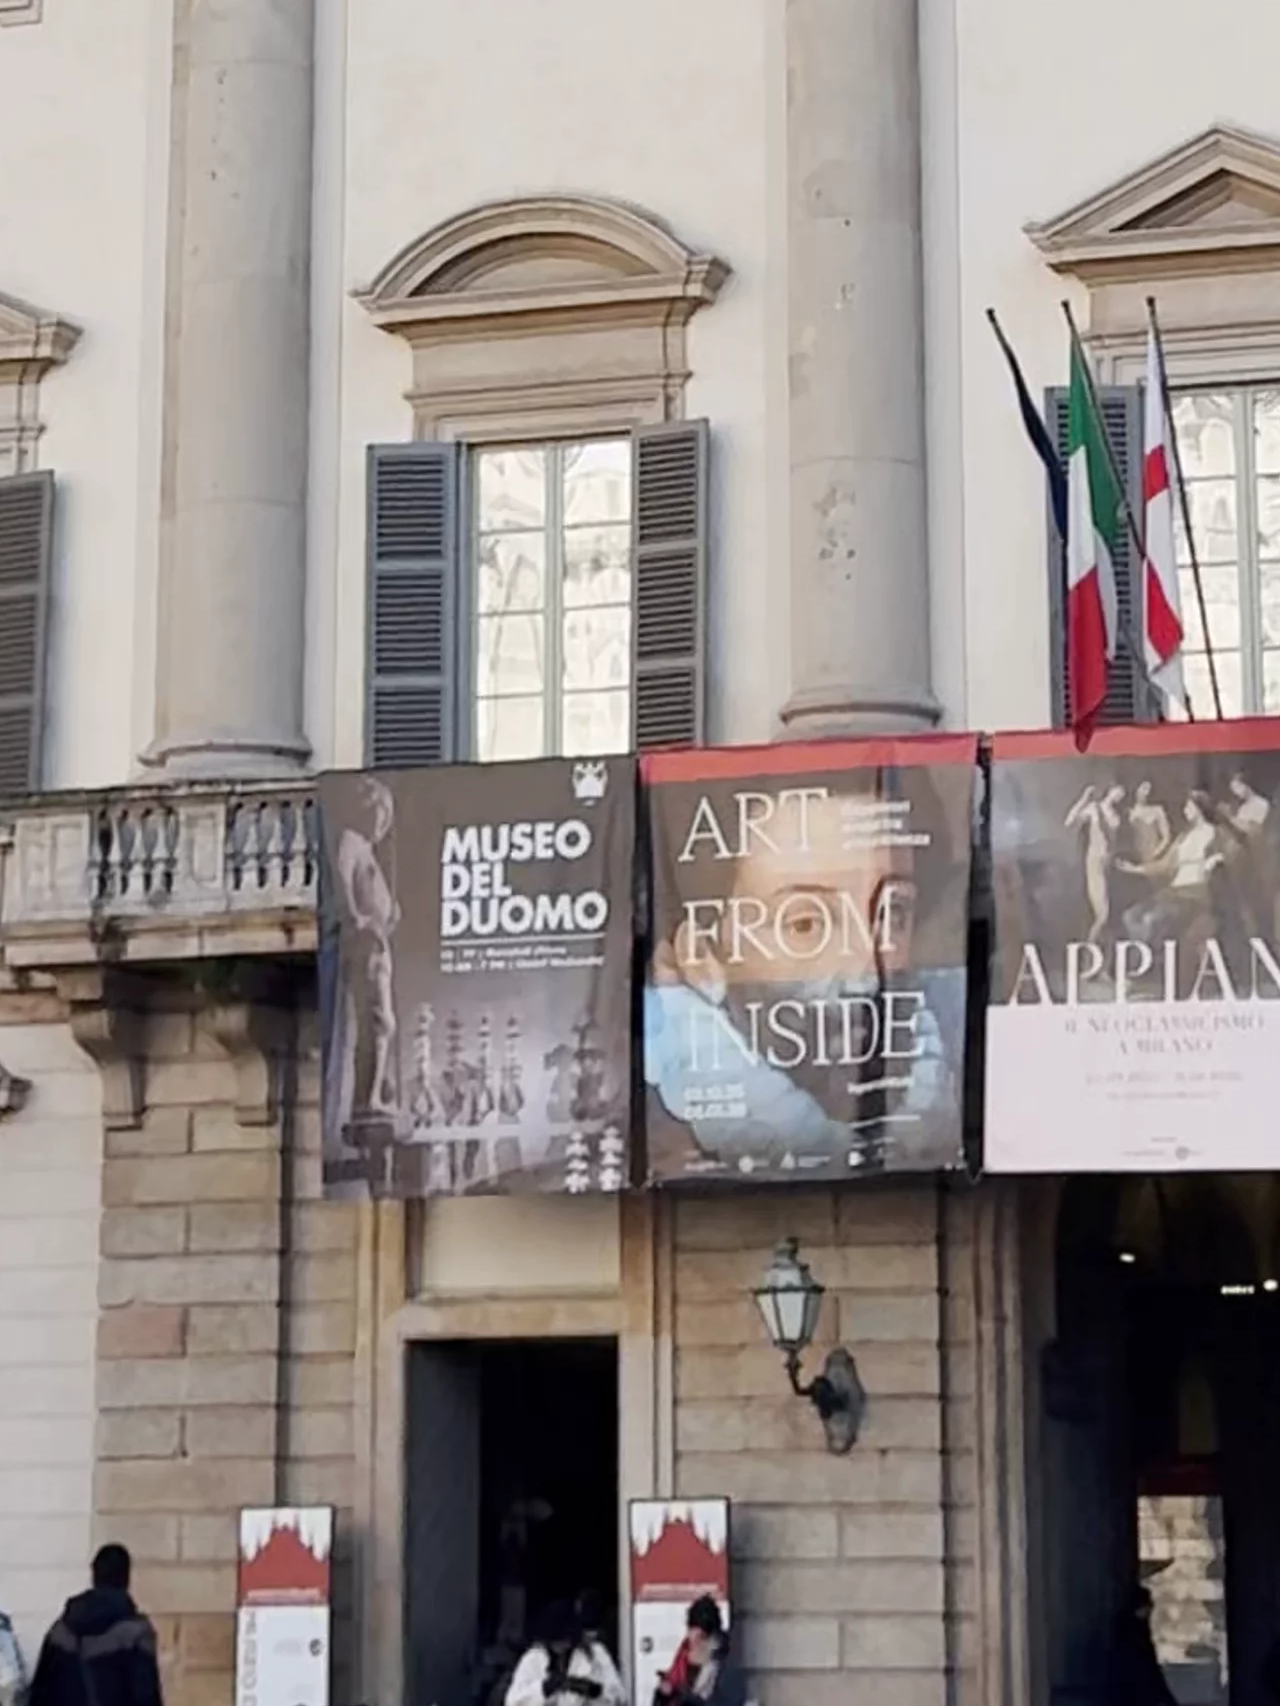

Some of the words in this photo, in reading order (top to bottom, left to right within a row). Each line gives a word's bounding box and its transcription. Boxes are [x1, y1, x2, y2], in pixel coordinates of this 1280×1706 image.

[441, 819, 592, 863] MUSEO
[677, 787, 828, 862] ART
[441, 862, 512, 898] DEL
[440, 890, 609, 936] DUOMO
[682, 886, 898, 967] FROM
[687, 990, 926, 1072] INSIDE
